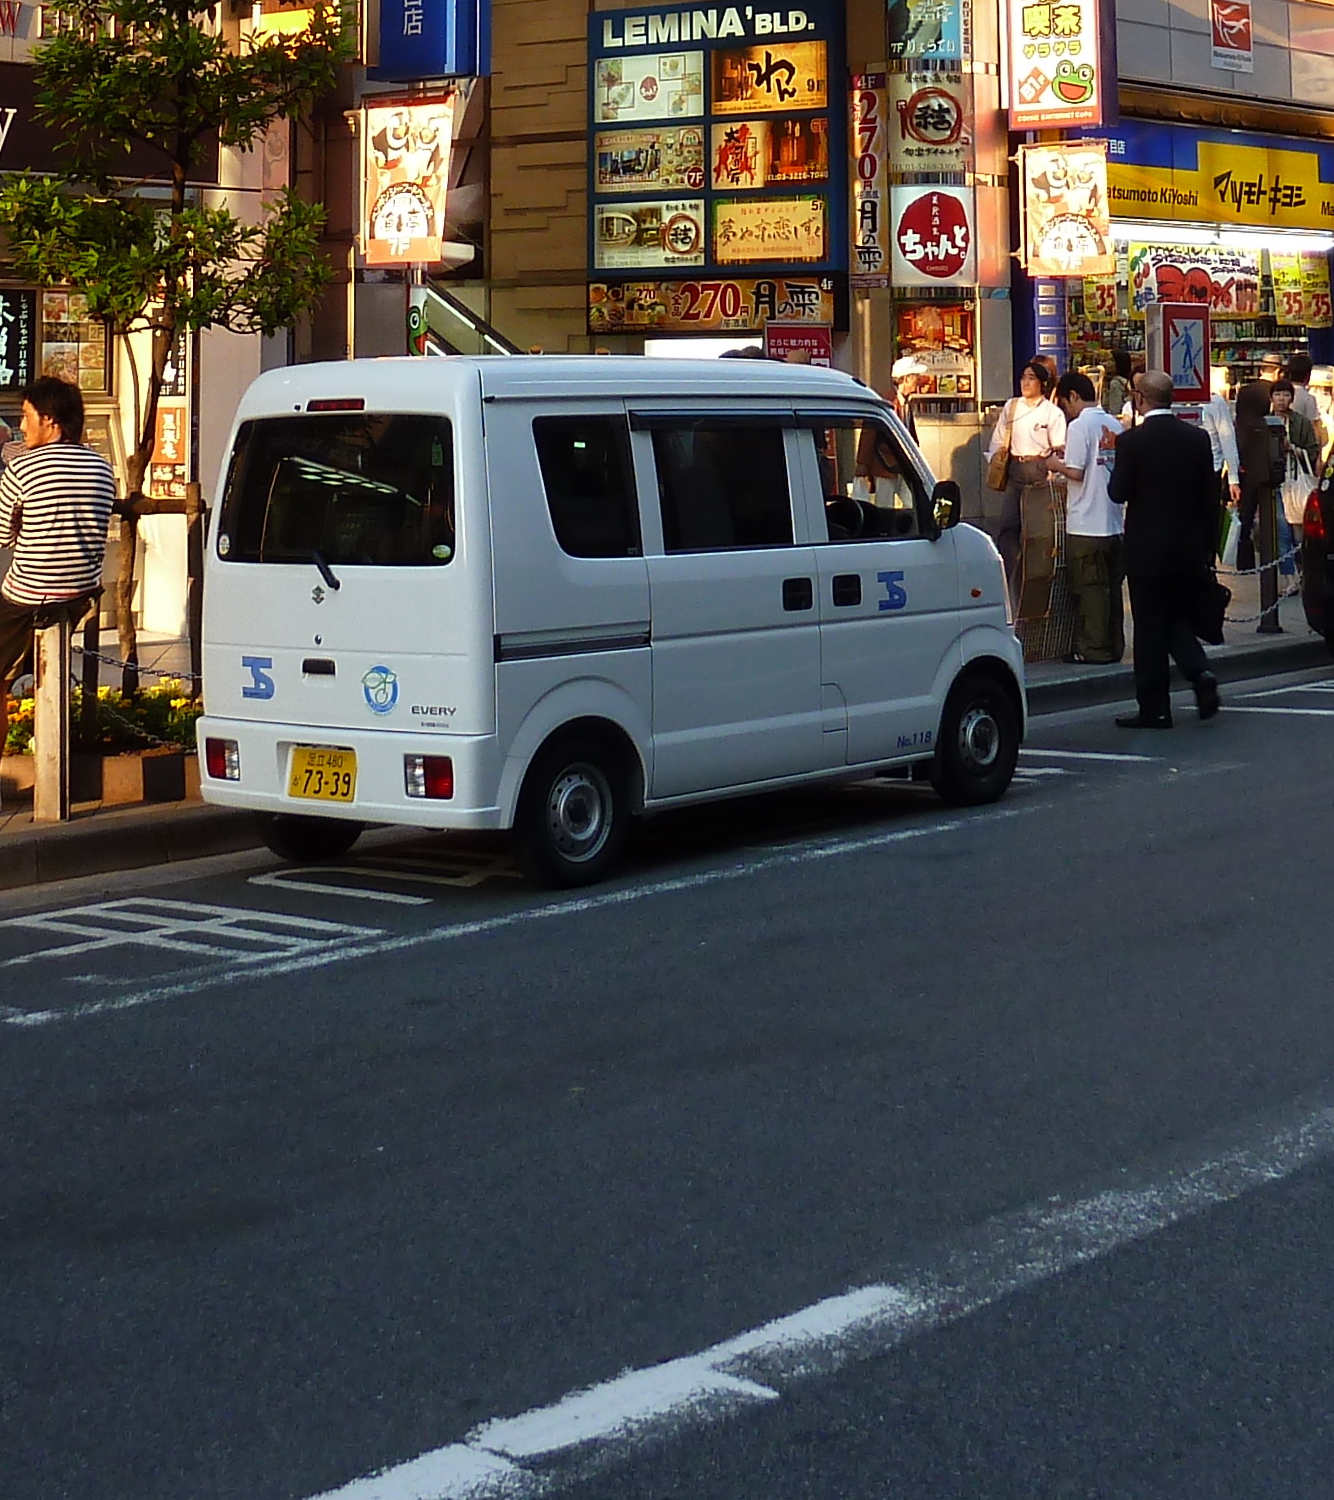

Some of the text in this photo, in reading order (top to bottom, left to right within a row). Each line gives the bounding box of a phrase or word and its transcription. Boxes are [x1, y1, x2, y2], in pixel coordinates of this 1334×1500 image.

[602, 5, 815, 48] LEMINA' BLD.
[1021, 4, 1083, 38] 喫茶
[891, 42, 904, 53] 7F
[1022, 40, 1083, 58] ゲラゲラ
[748, 49, 797, 103] わん
[856, 75, 876, 88] 4F
[914, 105, 952, 131] 結
[688, 171, 704, 186] 7F
[1106, 185, 1199, 209] atsumoto KiYoshi
[1213, 170, 1307, 216] マツモトキヨシ
[811, 200, 825, 212] 5F
[388, 238, 411, 256] 7F
[854, 200, 883, 271] 月の雫
[900, 224, 967, 261] ちゃんと。
[636, 287, 656, 301] 270
[820, 278, 834, 292] 4F
[671, 284, 749, 321] 全品 270 円
[751, 281, 822, 322] 月の雫
[1096, 284, 1116, 311] 35
[1282, 292, 1303, 316] 35
[1311, 293, 1331, 316] 35
[90, 327, 104, 339] 2F
[411, 704, 458, 717] EVERY
[896, 731, 933, 750] No.118
[307, 753, 345, 769] 足立 480
[302, 769, 352, 798] 73-39
